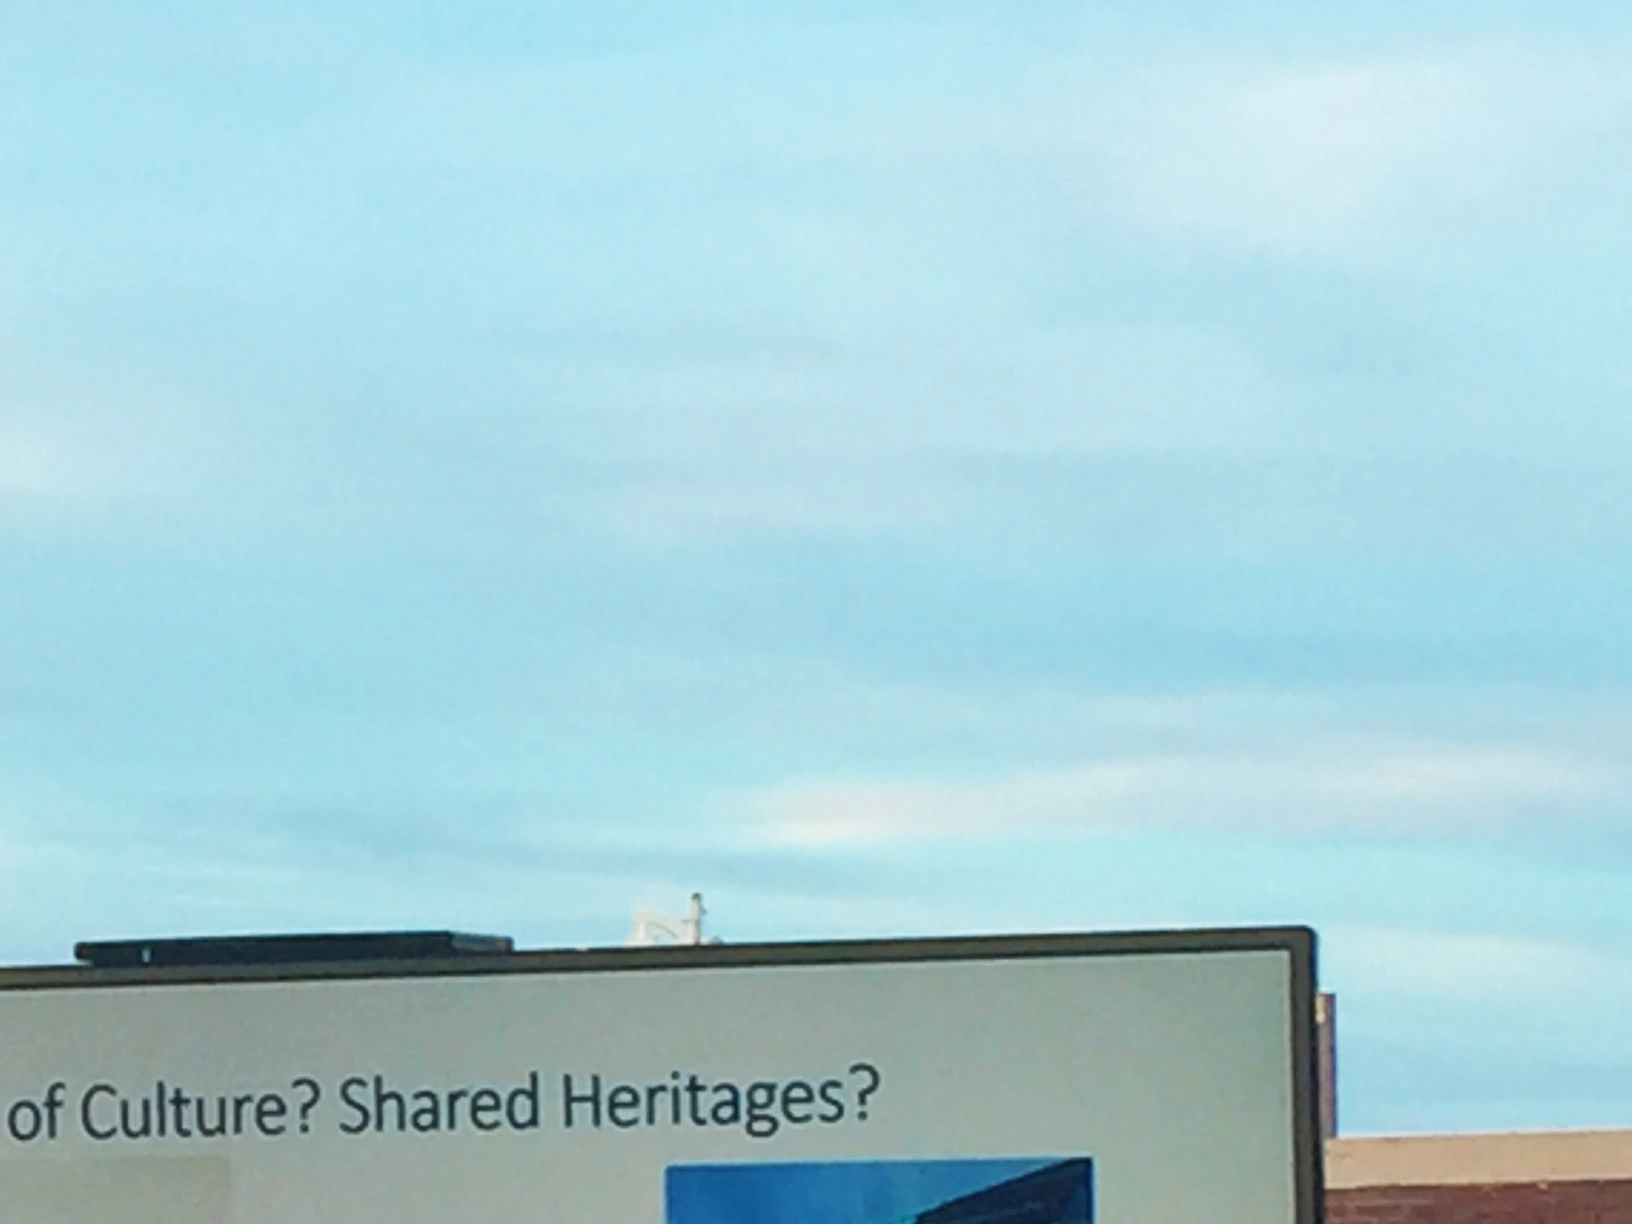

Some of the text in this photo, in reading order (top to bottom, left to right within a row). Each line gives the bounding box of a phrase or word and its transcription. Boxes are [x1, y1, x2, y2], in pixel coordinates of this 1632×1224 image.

[7, 1082, 66, 1141] of
[80, 1077, 320, 1140] Culture?
[338, 1071, 540, 1134] Shared
[563, 1063, 880, 1138] Heritages?
